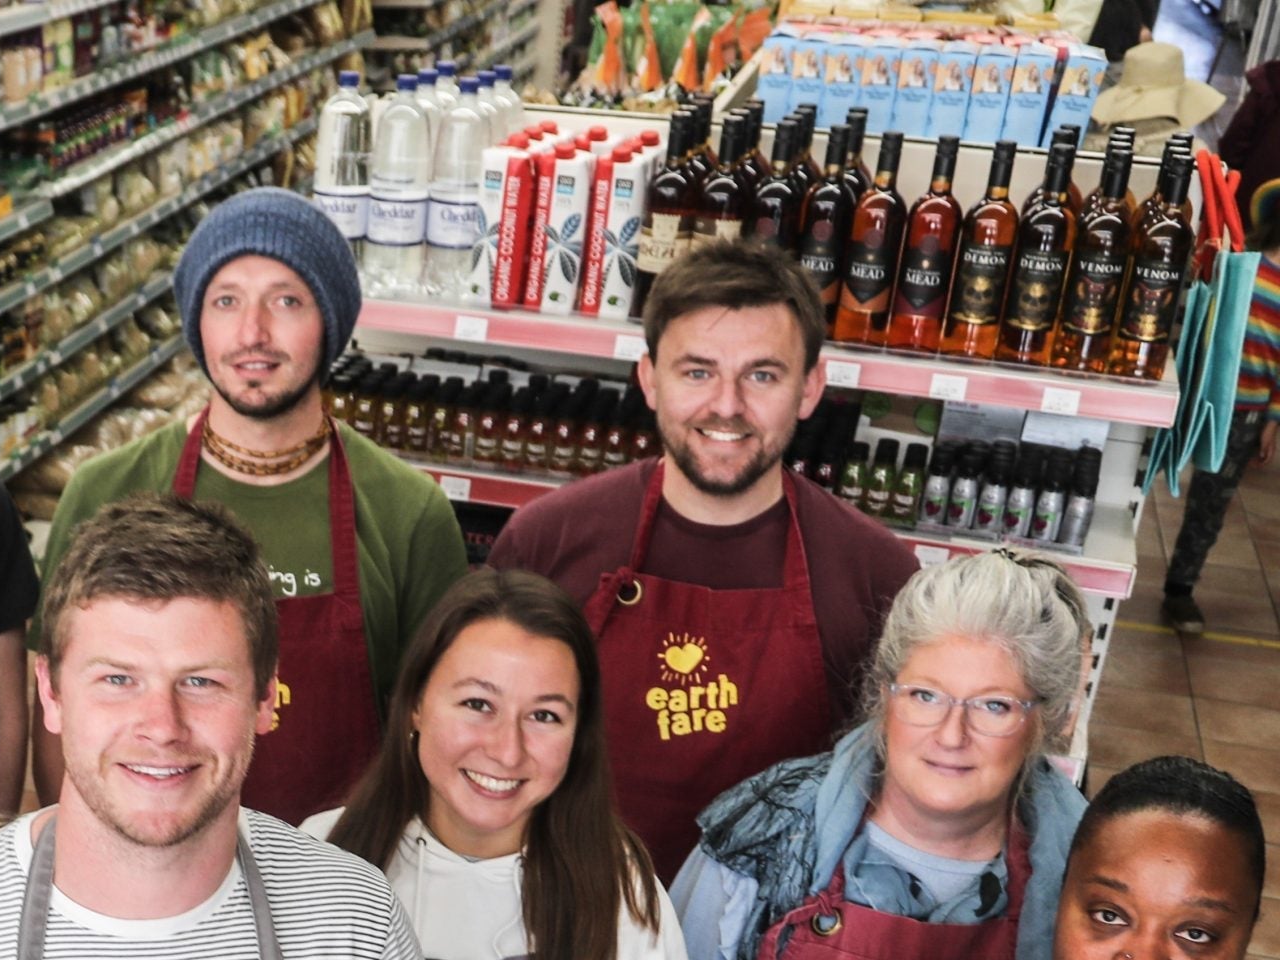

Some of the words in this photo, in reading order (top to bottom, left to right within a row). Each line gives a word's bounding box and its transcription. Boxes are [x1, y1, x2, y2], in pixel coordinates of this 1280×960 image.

[505, 176, 521, 208] WATER
[536, 176, 552, 208] WATER
[594, 179, 610, 212] WATER
[500, 208, 518, 256] COCONUT
[532, 208, 548, 255] COCONUT
[589, 211, 606, 260] COCONUT
[800, 258, 835, 272] MEAD
[849, 264, 885, 280] MEAD
[963, 251, 1007, 265] DEMON
[1020, 257, 1063, 271] DEMON
[1079, 260, 1123, 274] VENOM
[1136, 265, 1179, 281] VENOM
[495, 256, 513, 301] ORGANIC
[526, 256, 542, 301] ORGANIC
[583, 260, 601, 306] ORGANIC
[905, 271, 941, 286] MEAD
[304, 568, 322, 587] is
[645, 673, 739, 712] earth
[656, 707, 727, 741] fare
